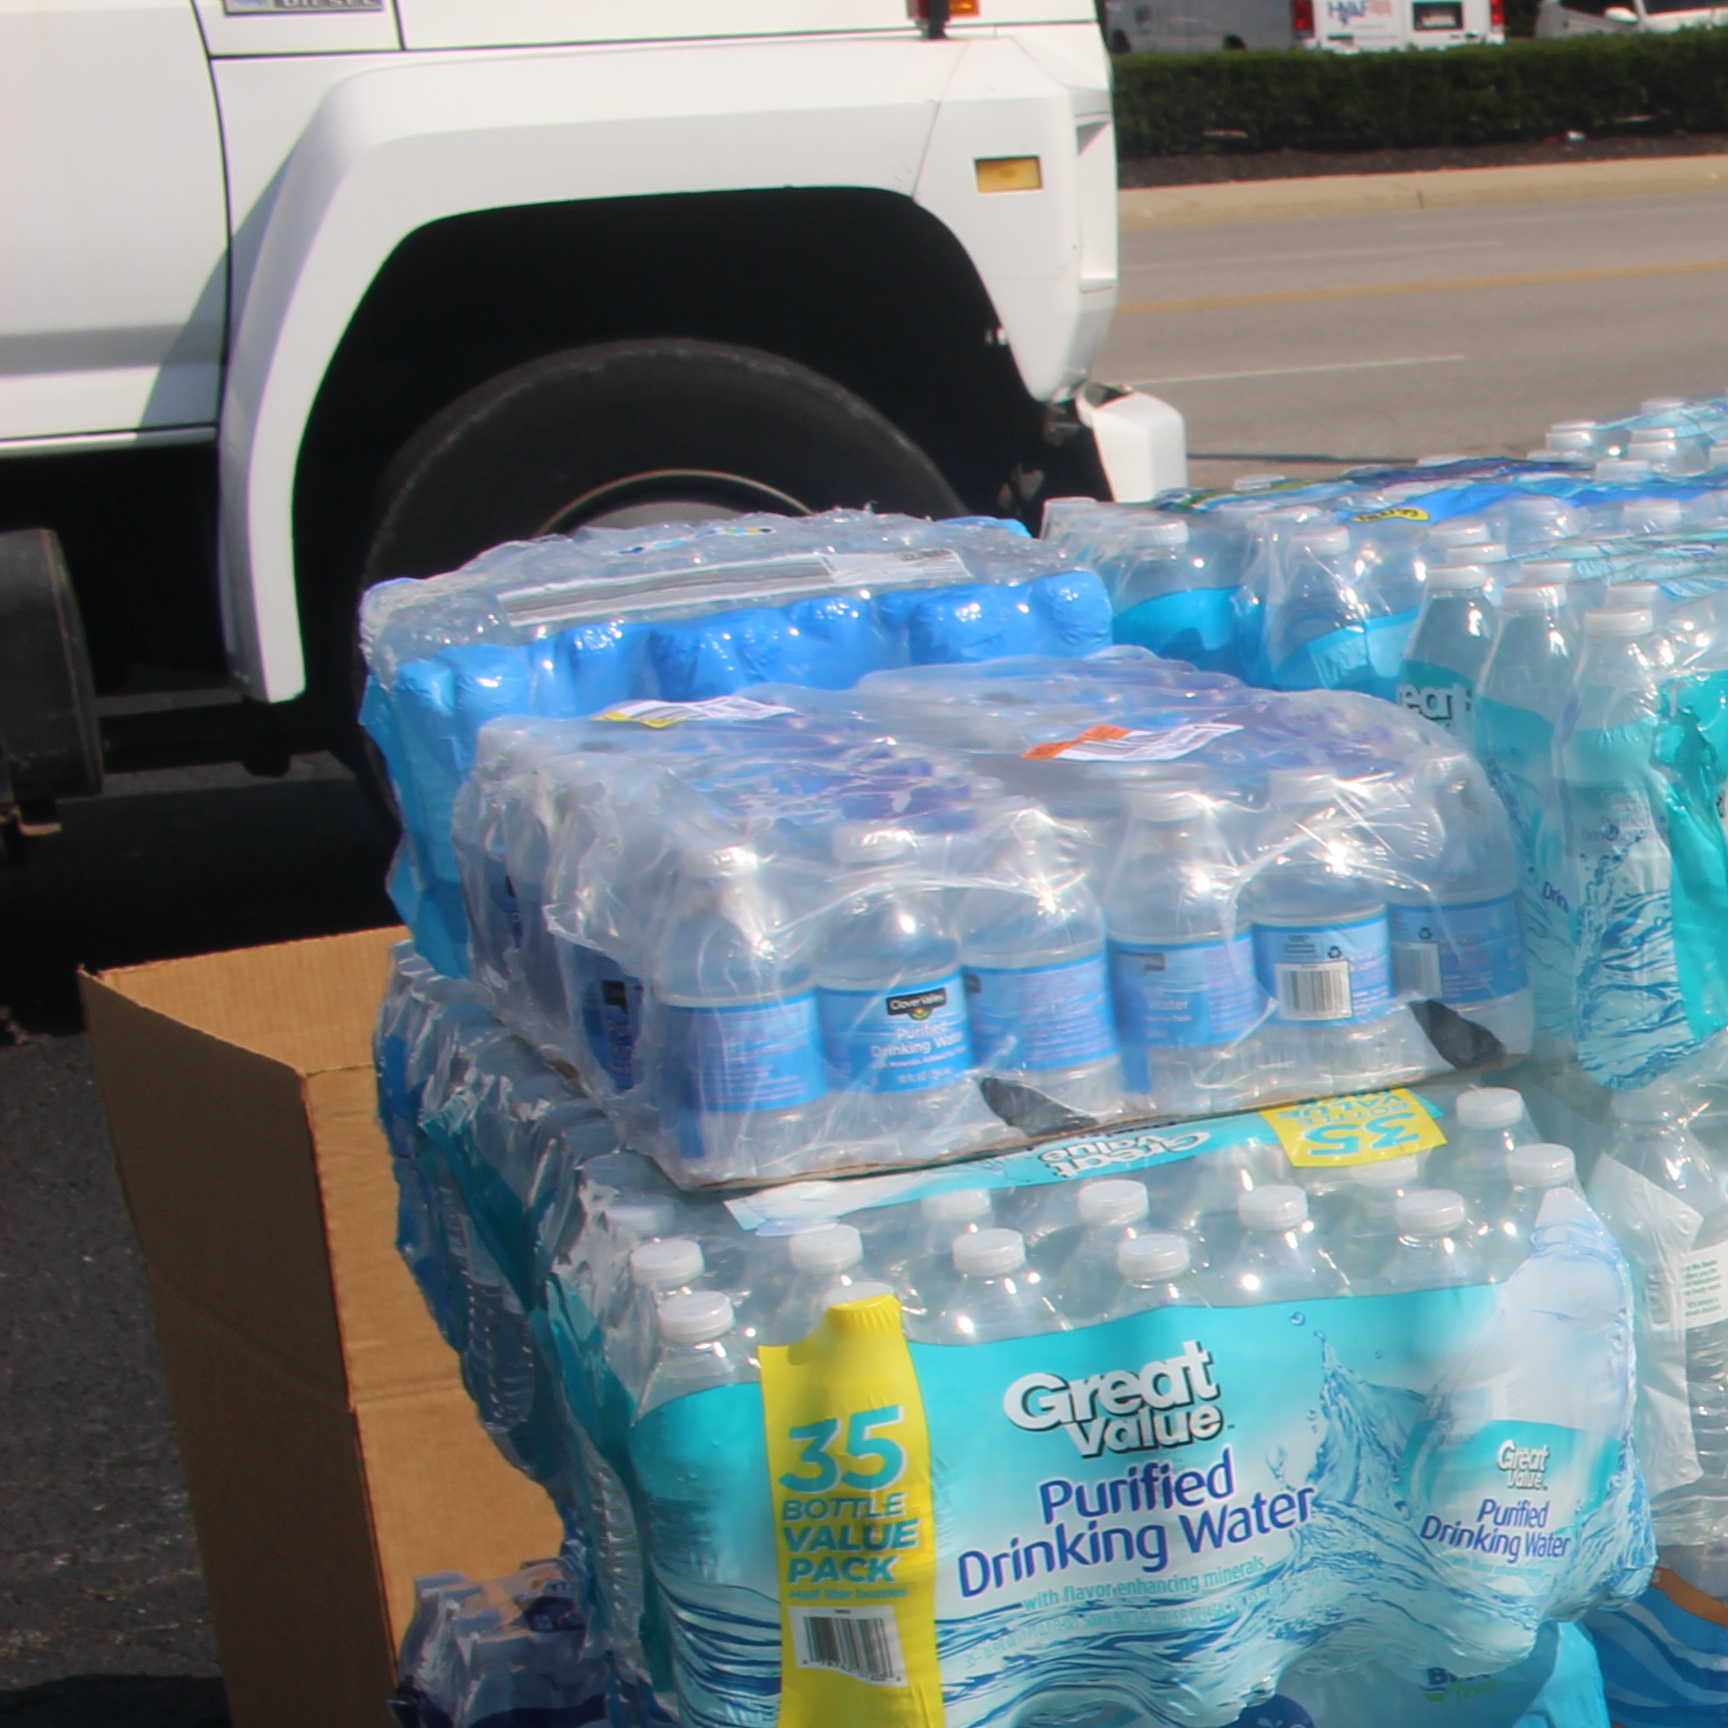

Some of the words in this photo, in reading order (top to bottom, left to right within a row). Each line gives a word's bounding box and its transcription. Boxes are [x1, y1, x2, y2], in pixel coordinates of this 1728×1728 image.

[1300, 1112, 1420, 1157] 35
[1004, 1338, 1223, 1431] Great
[777, 1404, 907, 1494] 35
[1066, 1402, 1228, 1460] Value
[1497, 1438, 1552, 1475] Great
[781, 1492, 907, 1522] BOTTLE
[1038, 1447, 1236, 1525] Purified
[781, 1518, 920, 1554] VALUE
[1478, 1498, 1549, 1529] Purified
[956, 1519, 1173, 1598] Drinking
[1179, 1486, 1318, 1556] Water
[1420, 1514, 1523, 1564] Drinking
[1523, 1526, 1572, 1561] Water
[787, 1554, 898, 1585] PACK
[1021, 1588, 1060, 1612] with
[1063, 1583, 1114, 1604] flavor
[1116, 1574, 1200, 1600] enhancing
[1202, 1559, 1267, 1589] minerals
